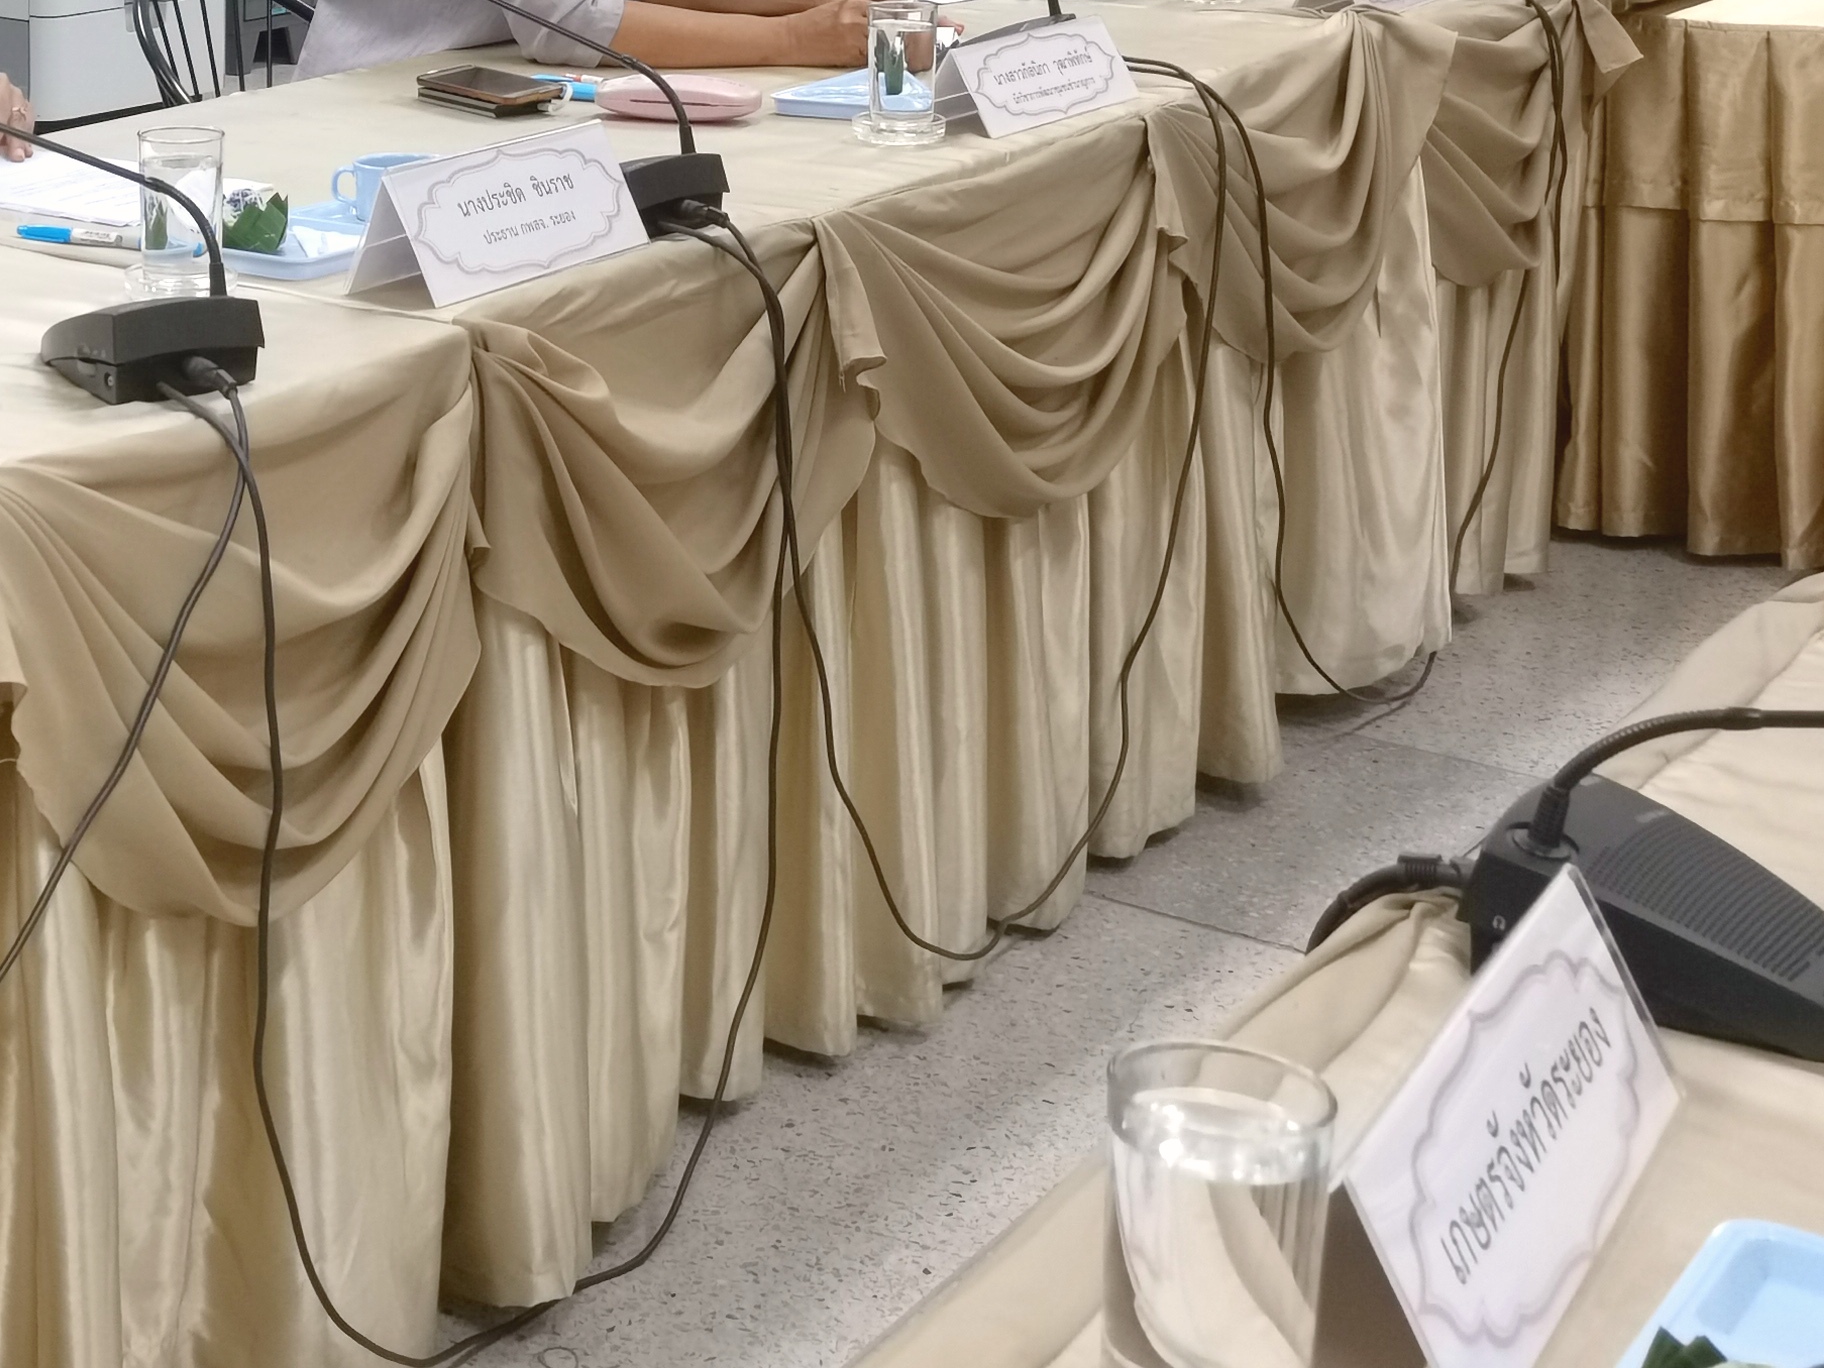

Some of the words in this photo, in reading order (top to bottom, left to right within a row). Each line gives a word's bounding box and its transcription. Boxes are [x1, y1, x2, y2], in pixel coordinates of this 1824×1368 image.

[483, 226, 519, 245] ประธาน
[549, 210, 577, 227] ระยอง
[1440, 1005, 1612, 1286] เกษตรจังหวัดระยอง
